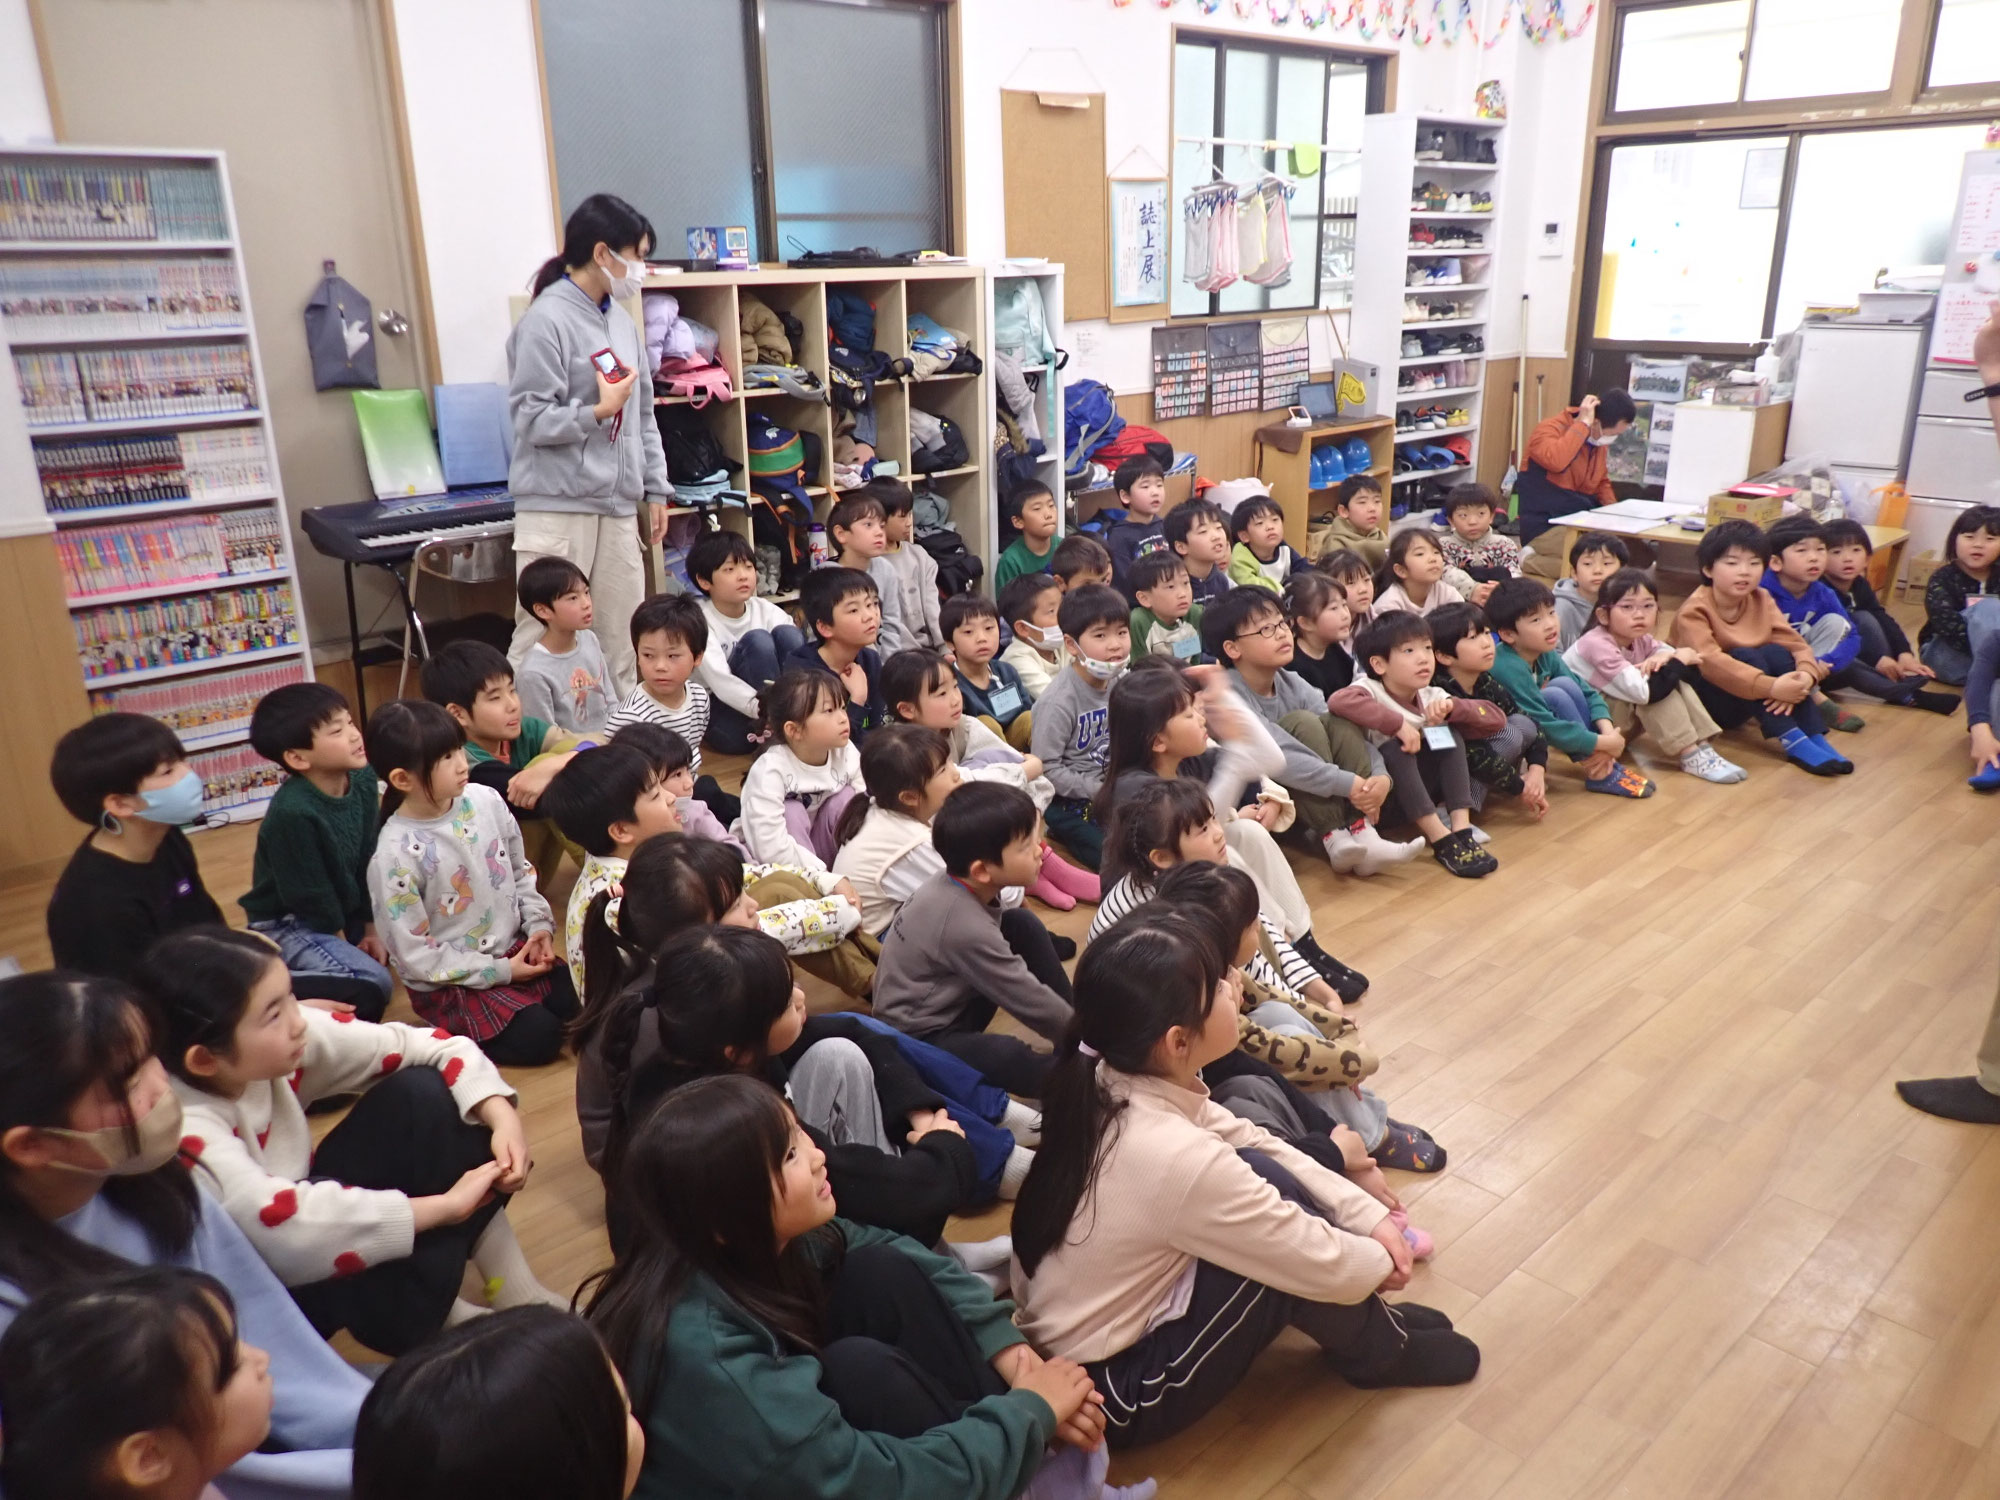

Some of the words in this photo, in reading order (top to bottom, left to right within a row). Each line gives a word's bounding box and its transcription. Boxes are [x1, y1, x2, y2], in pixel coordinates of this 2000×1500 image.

[1139, 200, 1157, 284] 誌上展
[1077, 706, 1110, 751] UT
